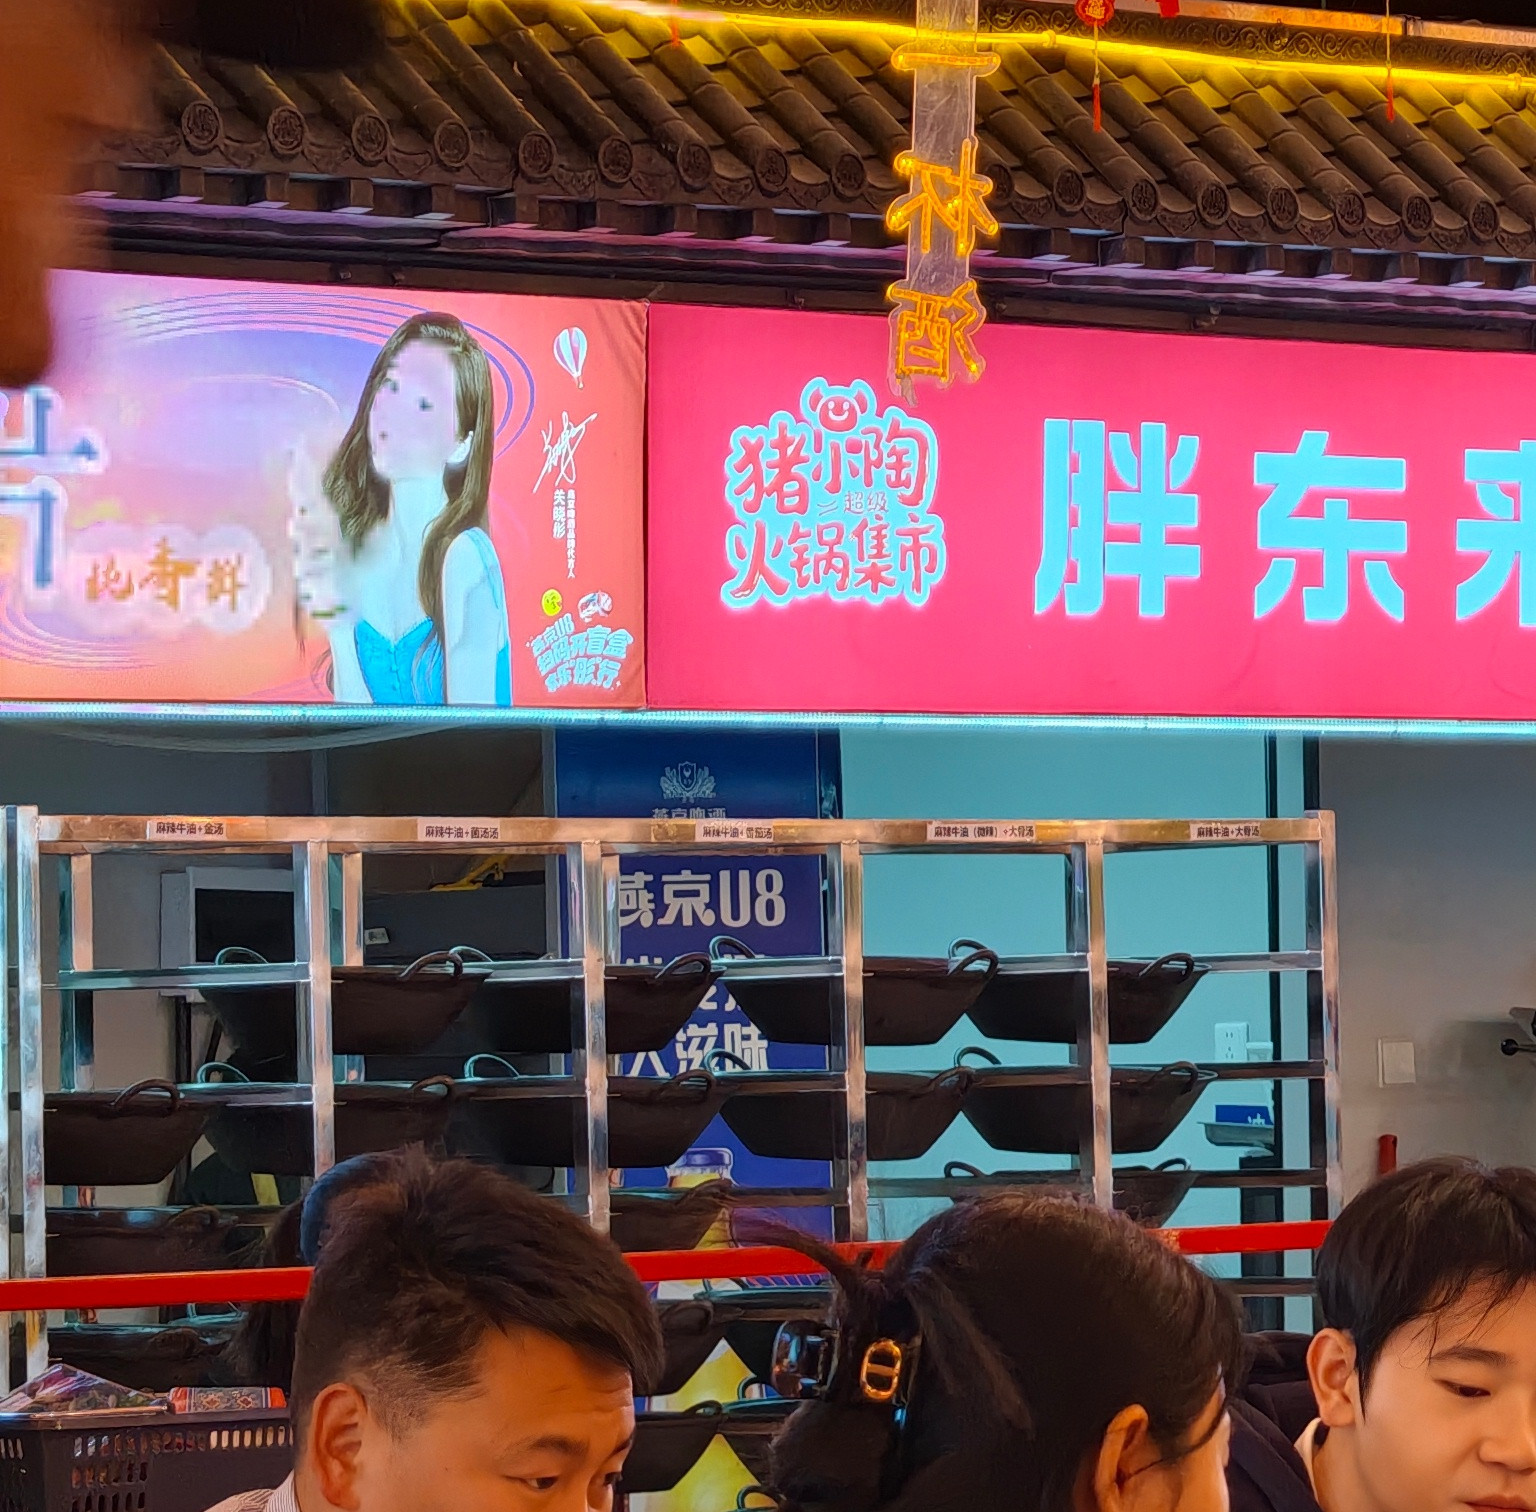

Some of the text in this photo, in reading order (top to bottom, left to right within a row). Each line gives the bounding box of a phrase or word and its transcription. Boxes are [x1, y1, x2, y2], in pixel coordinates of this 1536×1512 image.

[844, 491, 888, 514] 超级
[730, 513, 937, 599] 火锅集市
[619, 867, 786, 928] 燕京U8
